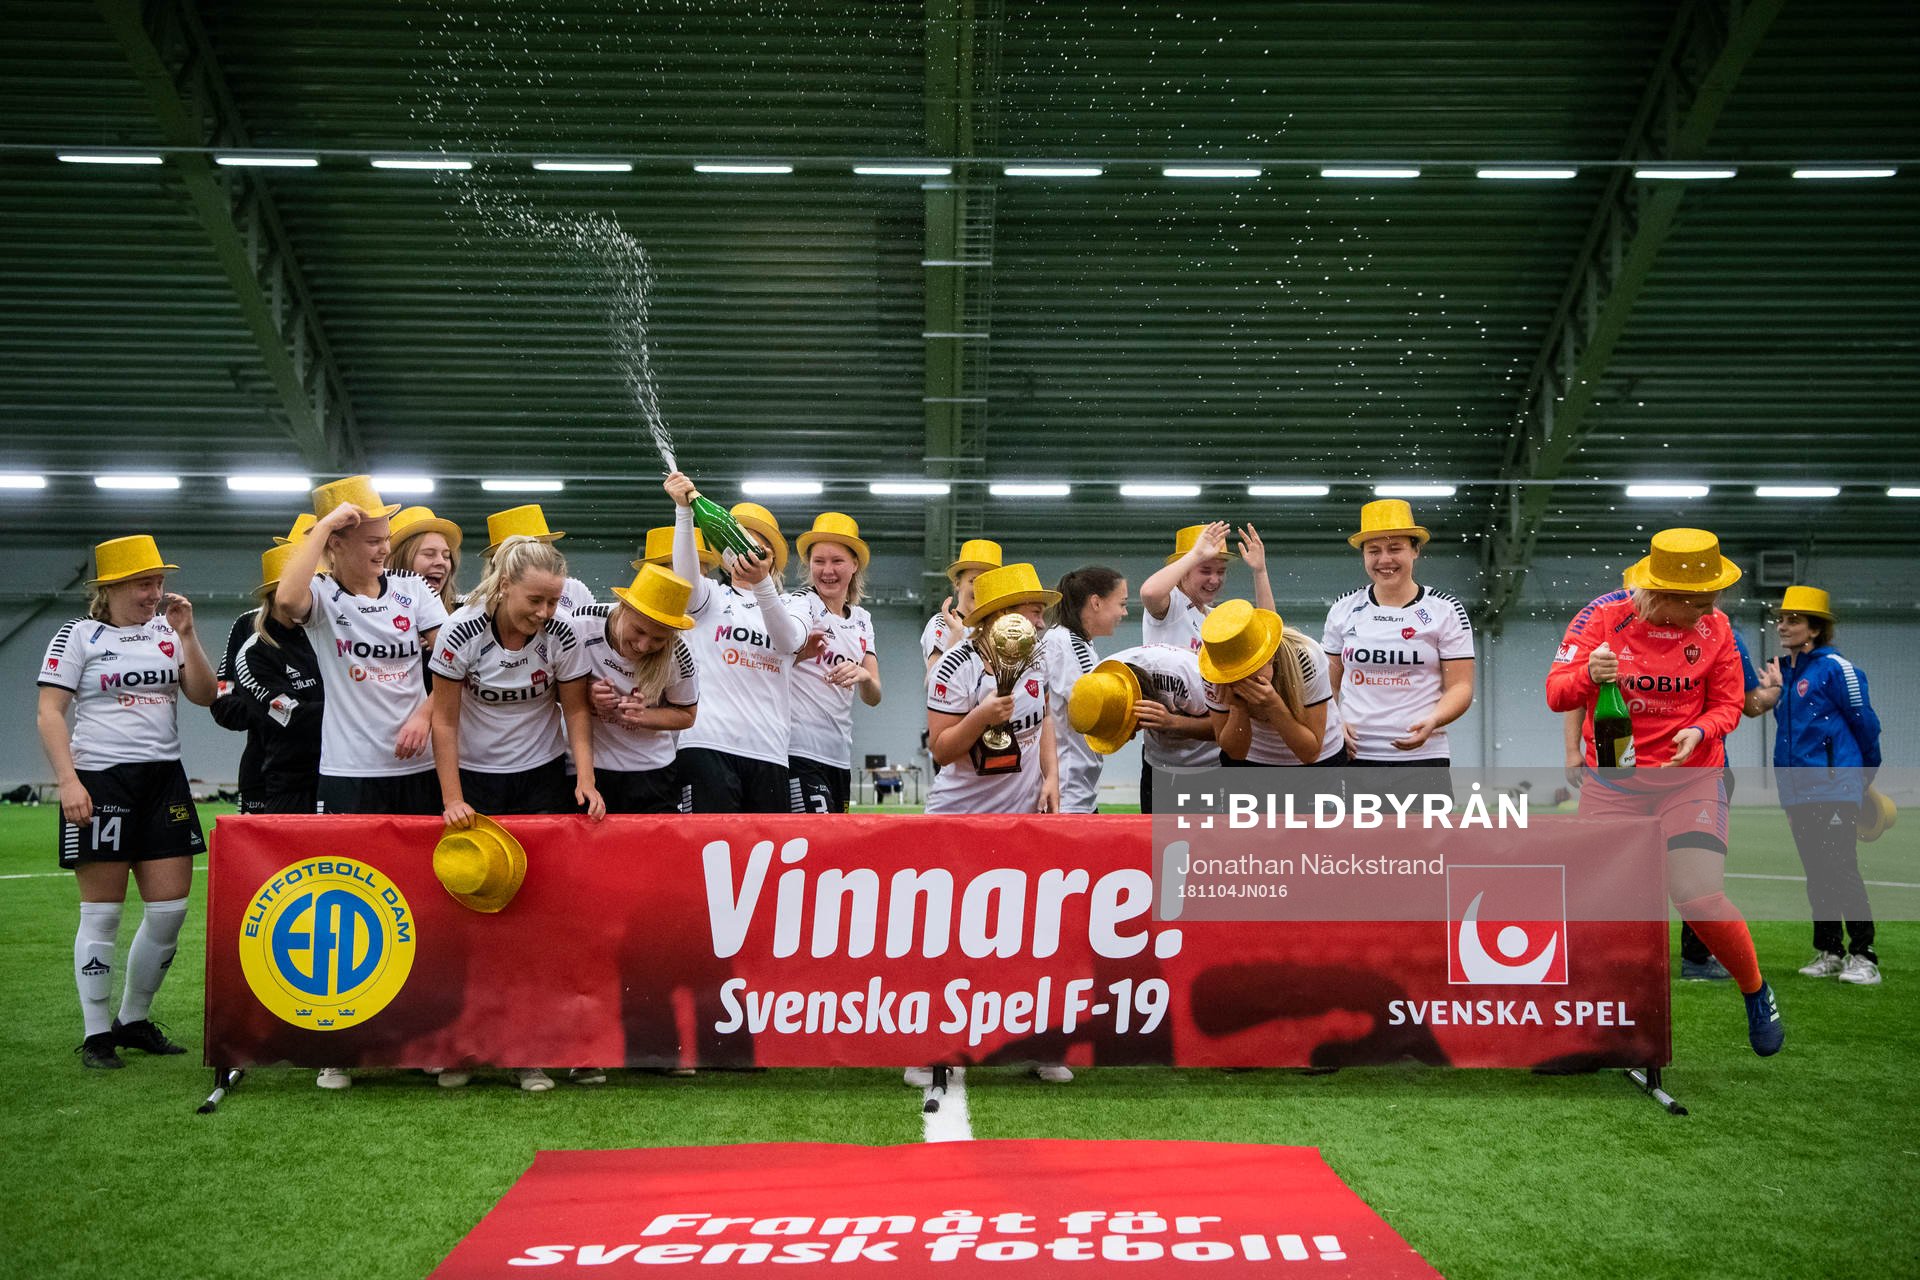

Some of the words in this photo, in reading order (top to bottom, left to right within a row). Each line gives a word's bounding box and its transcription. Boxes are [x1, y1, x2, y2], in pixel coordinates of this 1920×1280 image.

[120, 634, 151, 643] stadium
[336, 638, 418, 659] MOBILL
[1343, 647, 1424, 665] MOBILL
[1366, 678, 1412, 687] ELECTRA
[90, 816, 122, 851] 14
[245, 862, 377, 938] ELITFOTBOLL
[381, 887, 411, 943] DAM
[702, 837, 1190, 959] Vinnare!
[715, 976, 930, 1034] Svenska
[939, 976, 1051, 1047] Spel
[1062, 978, 1170, 1034] F-19
[1388, 1001, 1543, 1026] SVENSKA
[1554, 1001, 1636, 1027] SPEL
[640, 1209, 1036, 1237] Framåt
[1059, 1211, 1222, 1234] för
[507, 1235, 899, 1266] svensk
[925, 1234, 1347, 1261] fotboll!
